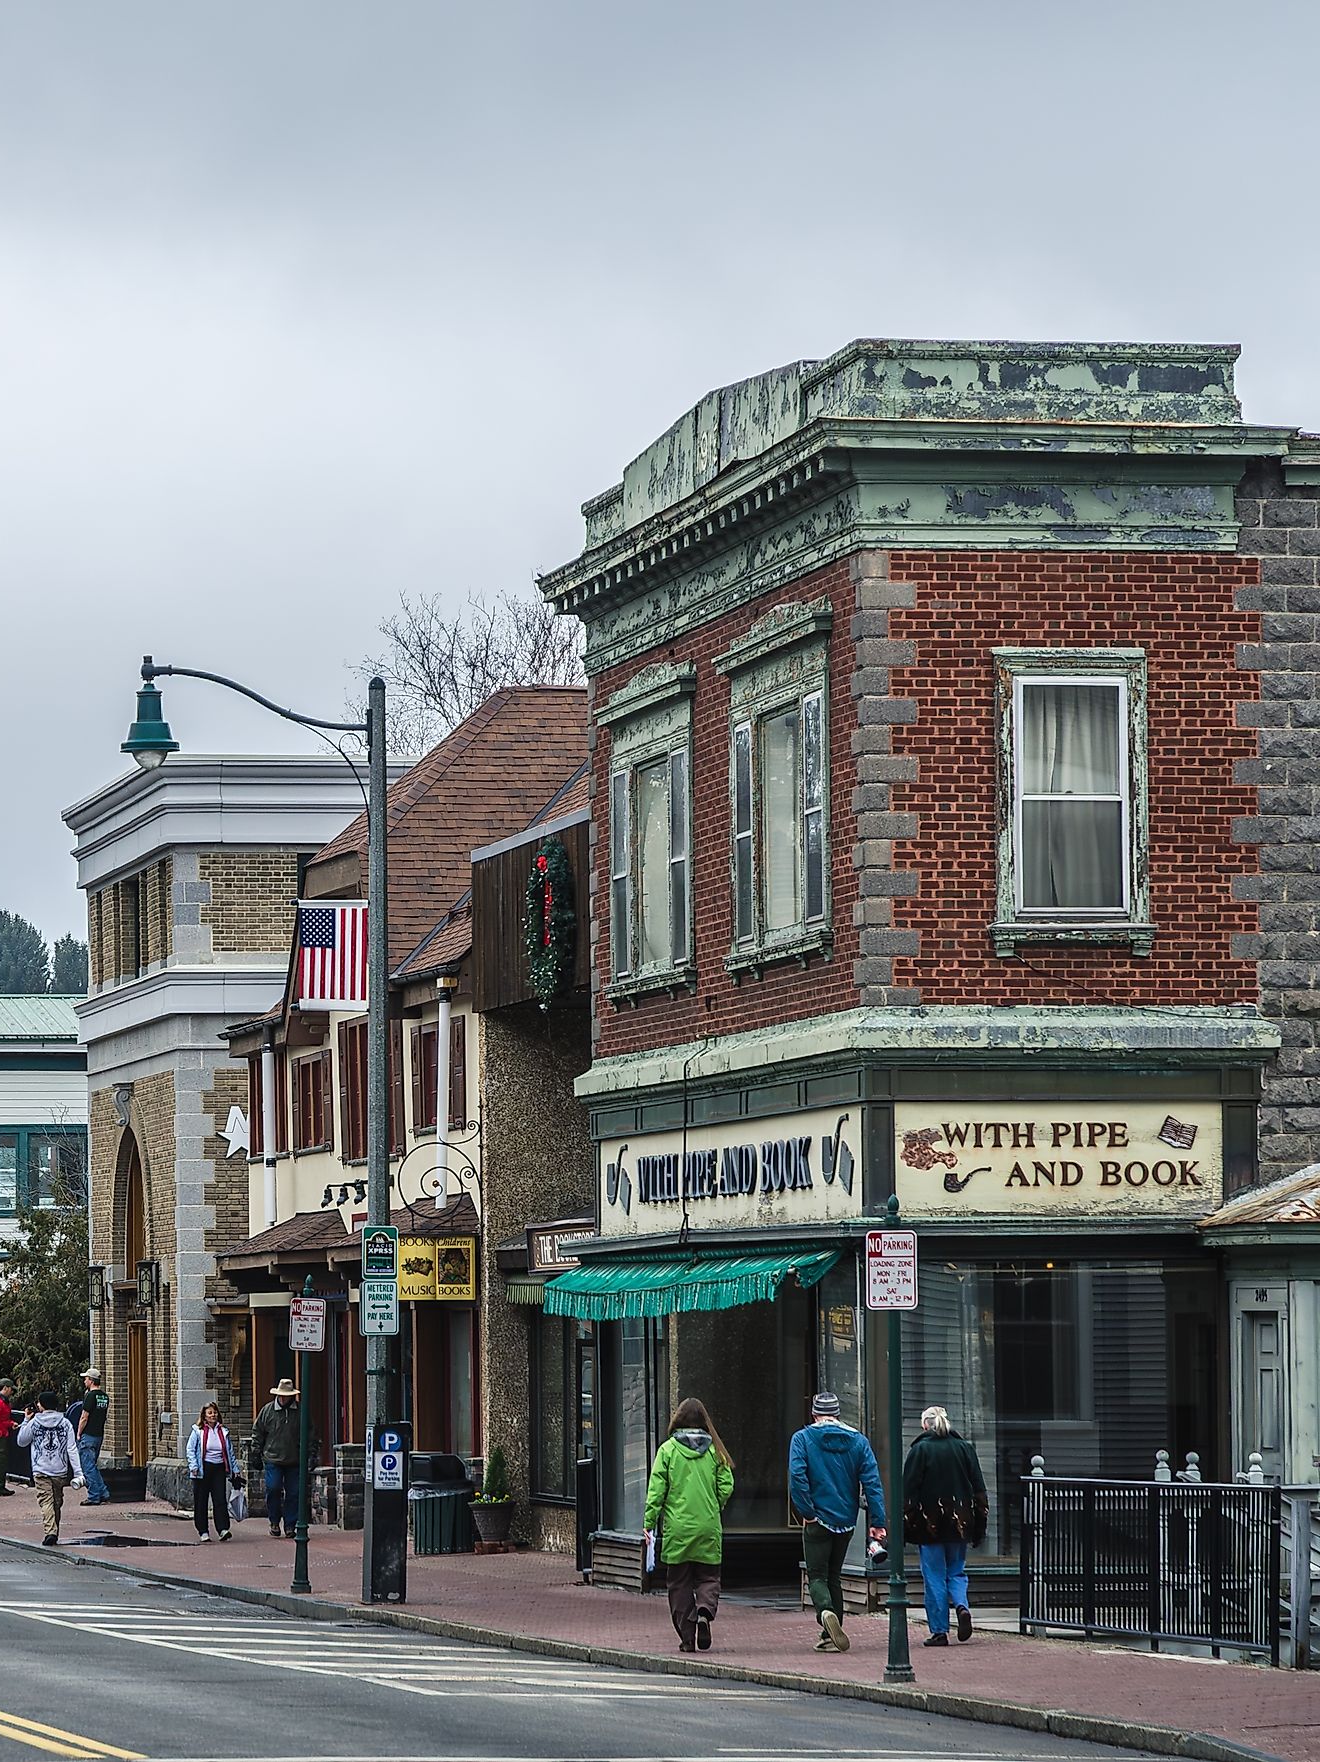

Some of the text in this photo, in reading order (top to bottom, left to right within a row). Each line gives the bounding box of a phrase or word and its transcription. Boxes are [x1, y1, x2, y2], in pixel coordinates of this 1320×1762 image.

[941, 1122, 1130, 1148] WITH PIPE
[637, 1135, 814, 1202] WITH PIPE AND BOOK
[1004, 1160, 1203, 1187] AND BOOK
[399, 1237, 435, 1247] BOOKS
[869, 1238, 913, 1253] NO PARKING
[539, 1235, 553, 1264] THE
[367, 1284, 394, 1292] METERED
[400, 1286, 437, 1296] MUSIC
[438, 1287, 471, 1296] BOOKS
[886, 1287, 897, 1295] SAT
[368, 1293, 393, 1301] PARKING
[292, 1302, 323, 1313] NO PARKING
[367, 1312, 394, 1320] PAY HERE
[385, 1433, 398, 1450] P
[385, 1457, 394, 1469] P
